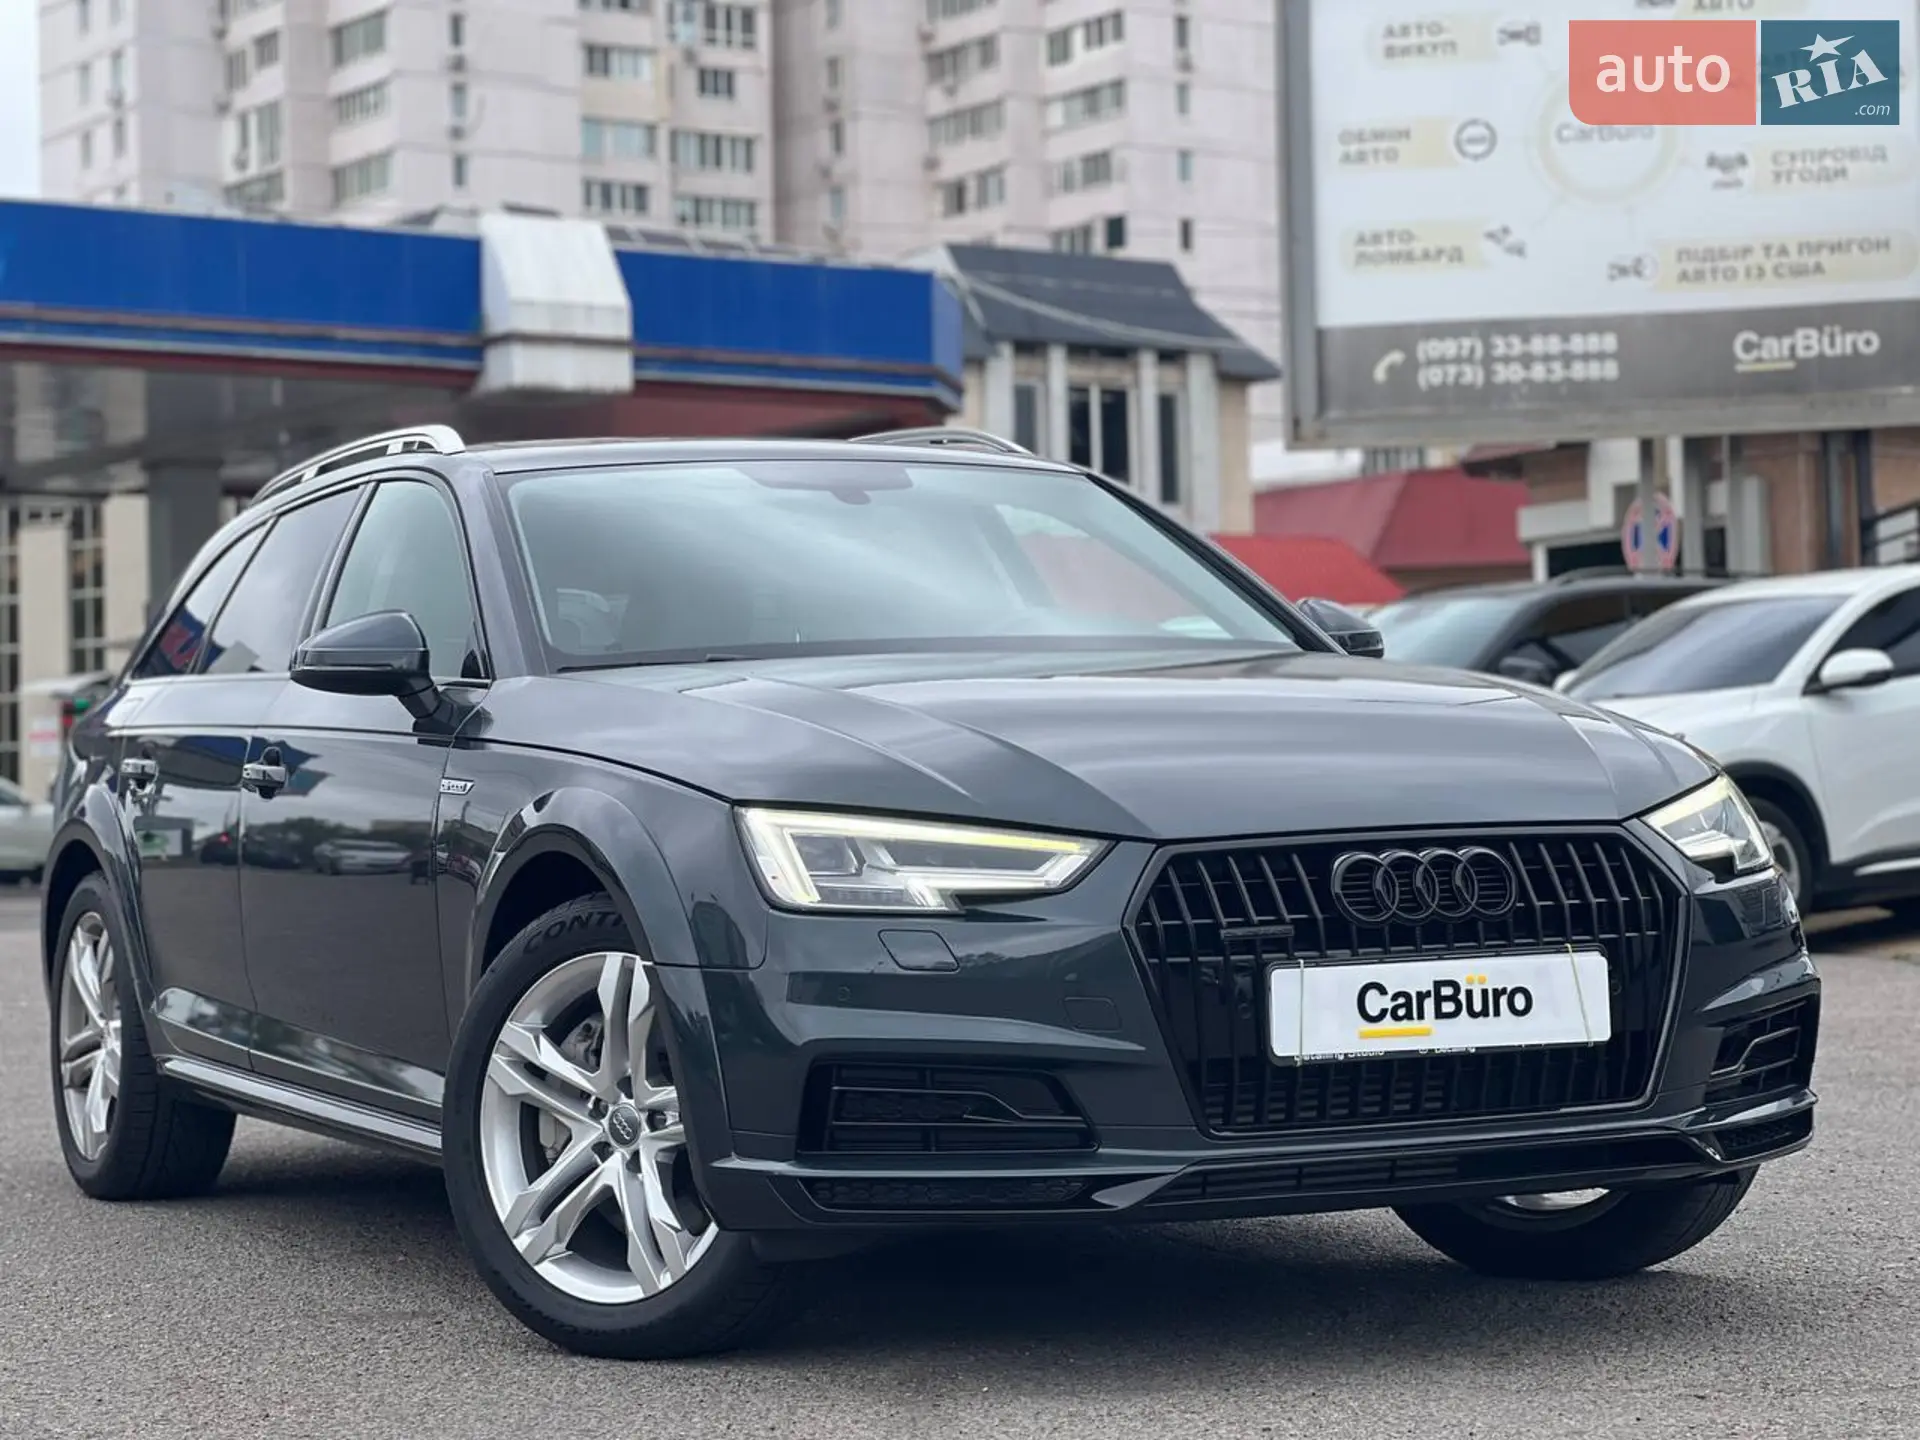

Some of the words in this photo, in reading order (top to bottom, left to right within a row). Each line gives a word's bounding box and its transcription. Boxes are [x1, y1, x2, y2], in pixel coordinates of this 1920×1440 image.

[1339, 146, 1400, 165] АВТО
[1771, 145, 1888, 167] СУПРОВІД
[1771, 166, 1848, 185] УГОДИ
[1355, 245, 1465, 267] ЛОМБАРД
[1676, 246, 1755, 264] ПІДБІР
[1761, 243, 1790, 260] ТА
[1797, 237, 1891, 258] ПРИГОН
[1677, 265, 1739, 284] АВТО
[1772, 260, 1826, 280] США
[1416, 335, 1484, 364] (097)
[1733, 324, 1881, 362] CarBüro
[1416, 362, 1485, 391] (073)
[1356, 974, 1534, 1023] CarBüro
